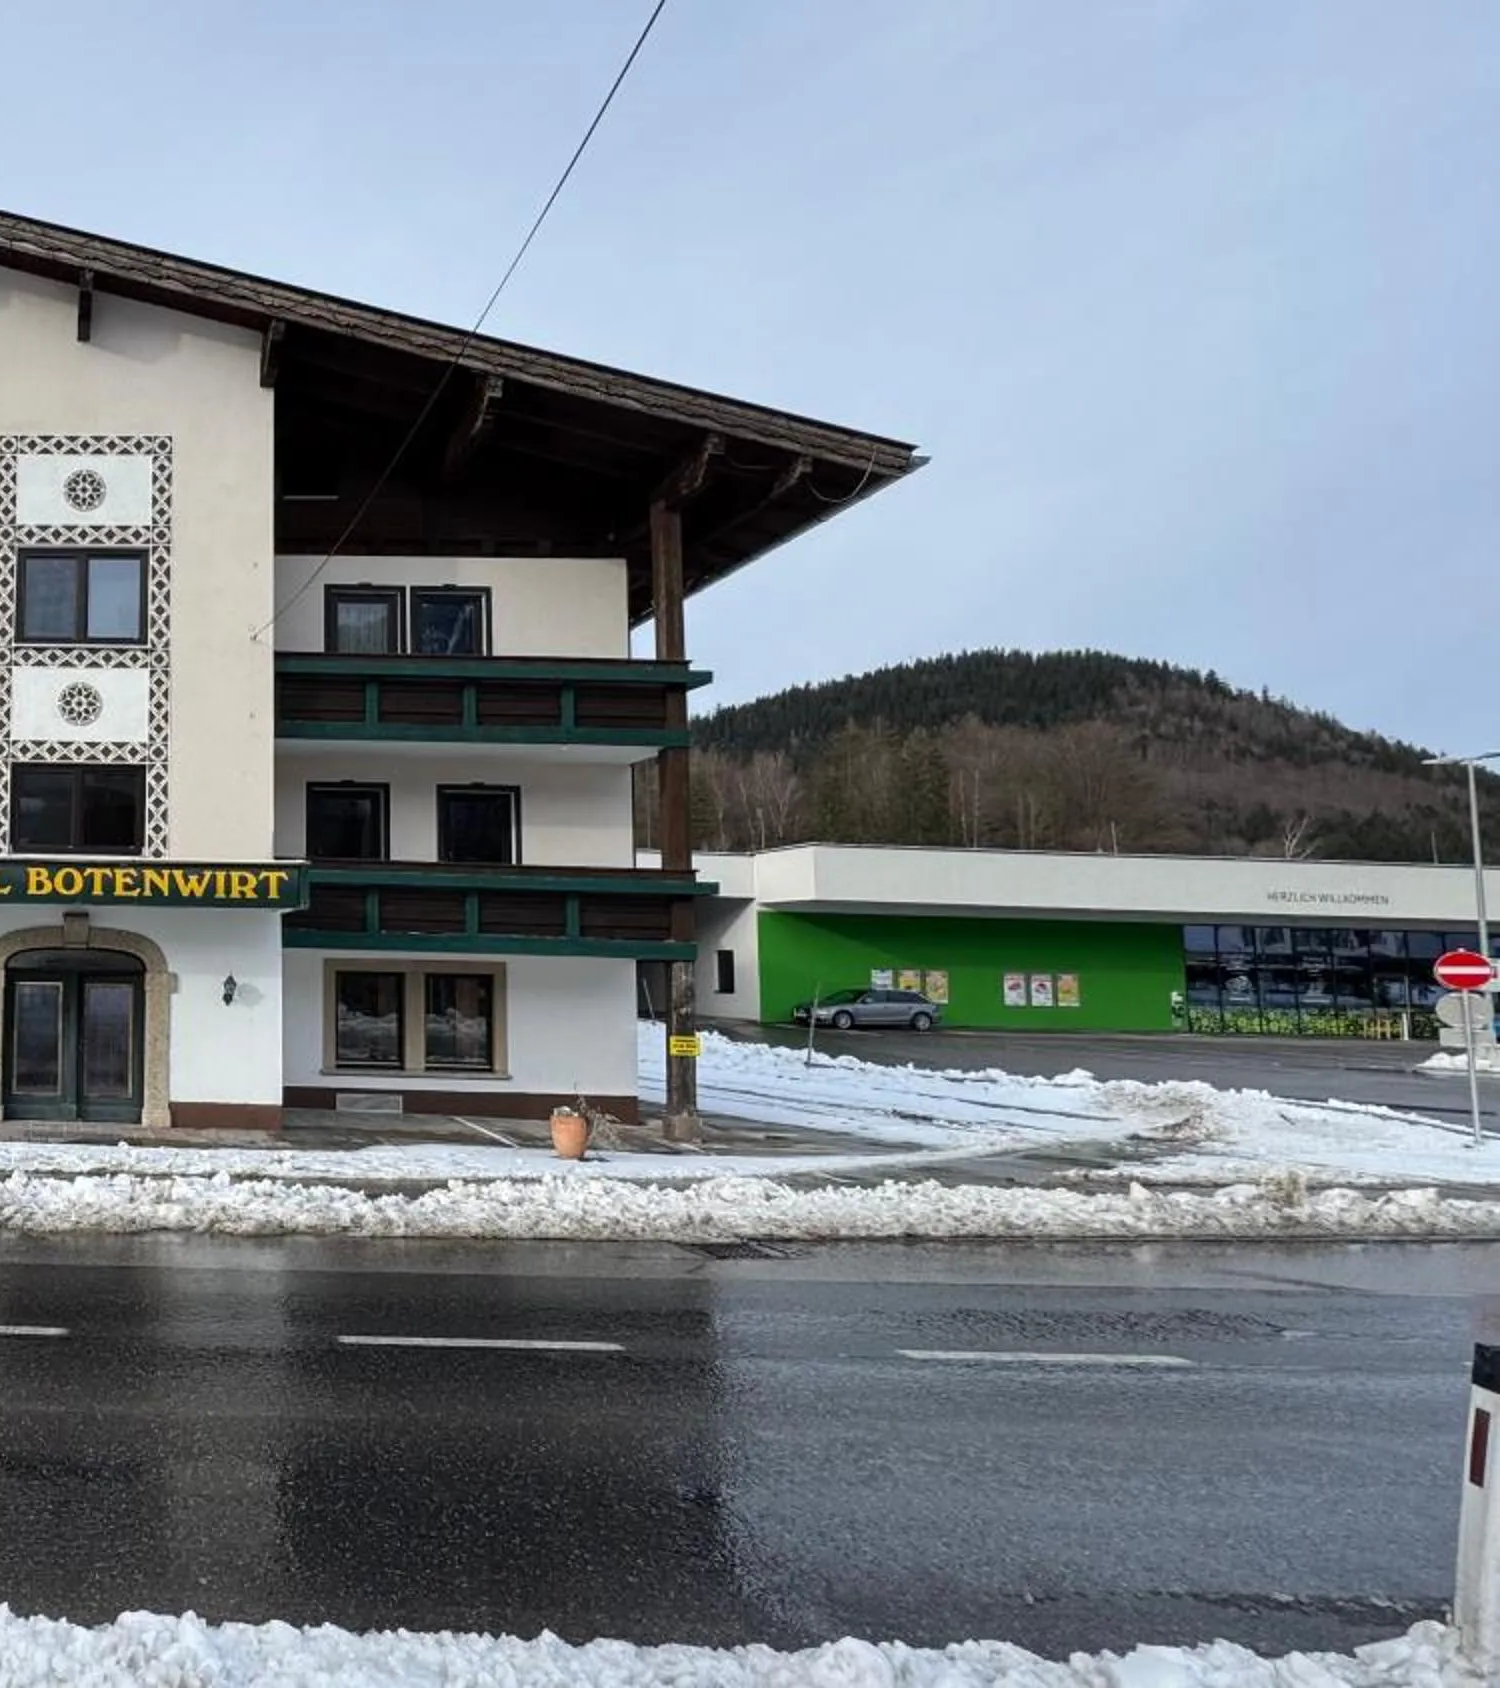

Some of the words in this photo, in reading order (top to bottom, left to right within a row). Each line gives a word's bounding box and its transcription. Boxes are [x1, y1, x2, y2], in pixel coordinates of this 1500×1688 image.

[27, 867, 289, 899] BOTENWIRT
[1267, 891, 1316, 903] HERZLICH
[1317, 893, 1389, 905] WILLKOMMEN
